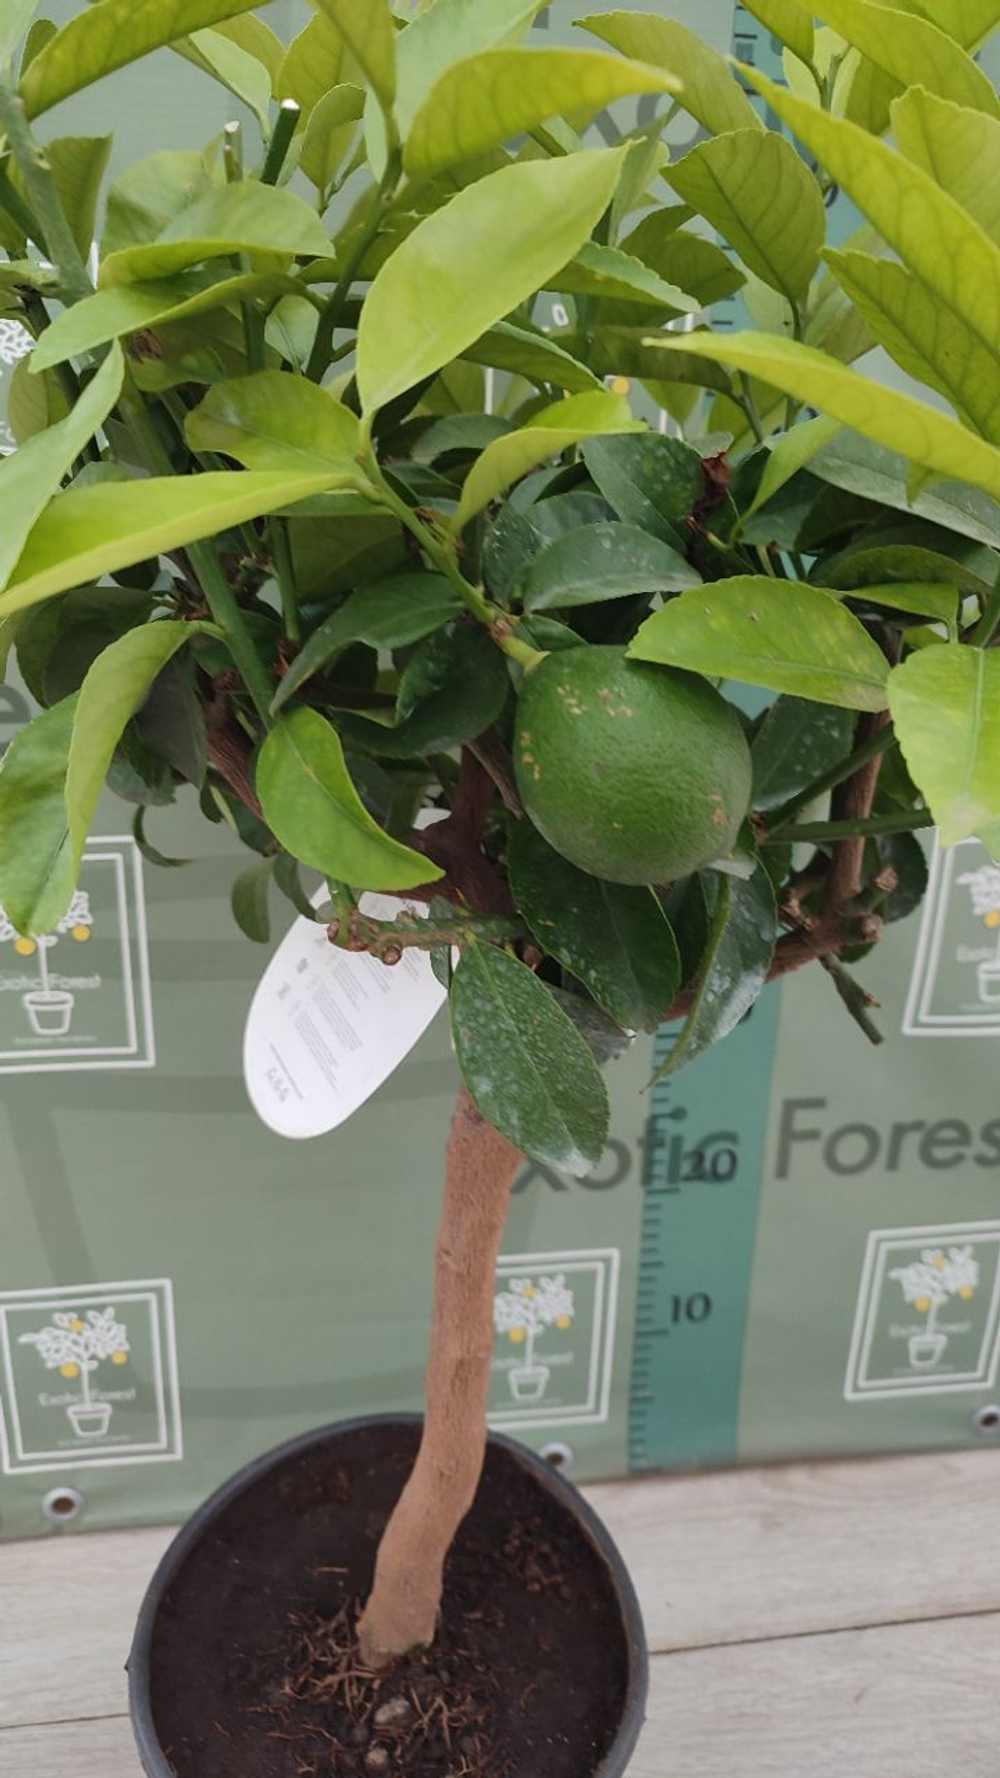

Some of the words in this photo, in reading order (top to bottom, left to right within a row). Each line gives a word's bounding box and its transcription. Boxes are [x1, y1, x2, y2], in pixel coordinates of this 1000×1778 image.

[511, 1107, 738, 1194] xotic
[682, 1147, 737, 1183] 20
[670, 1291, 712, 1324] 10
